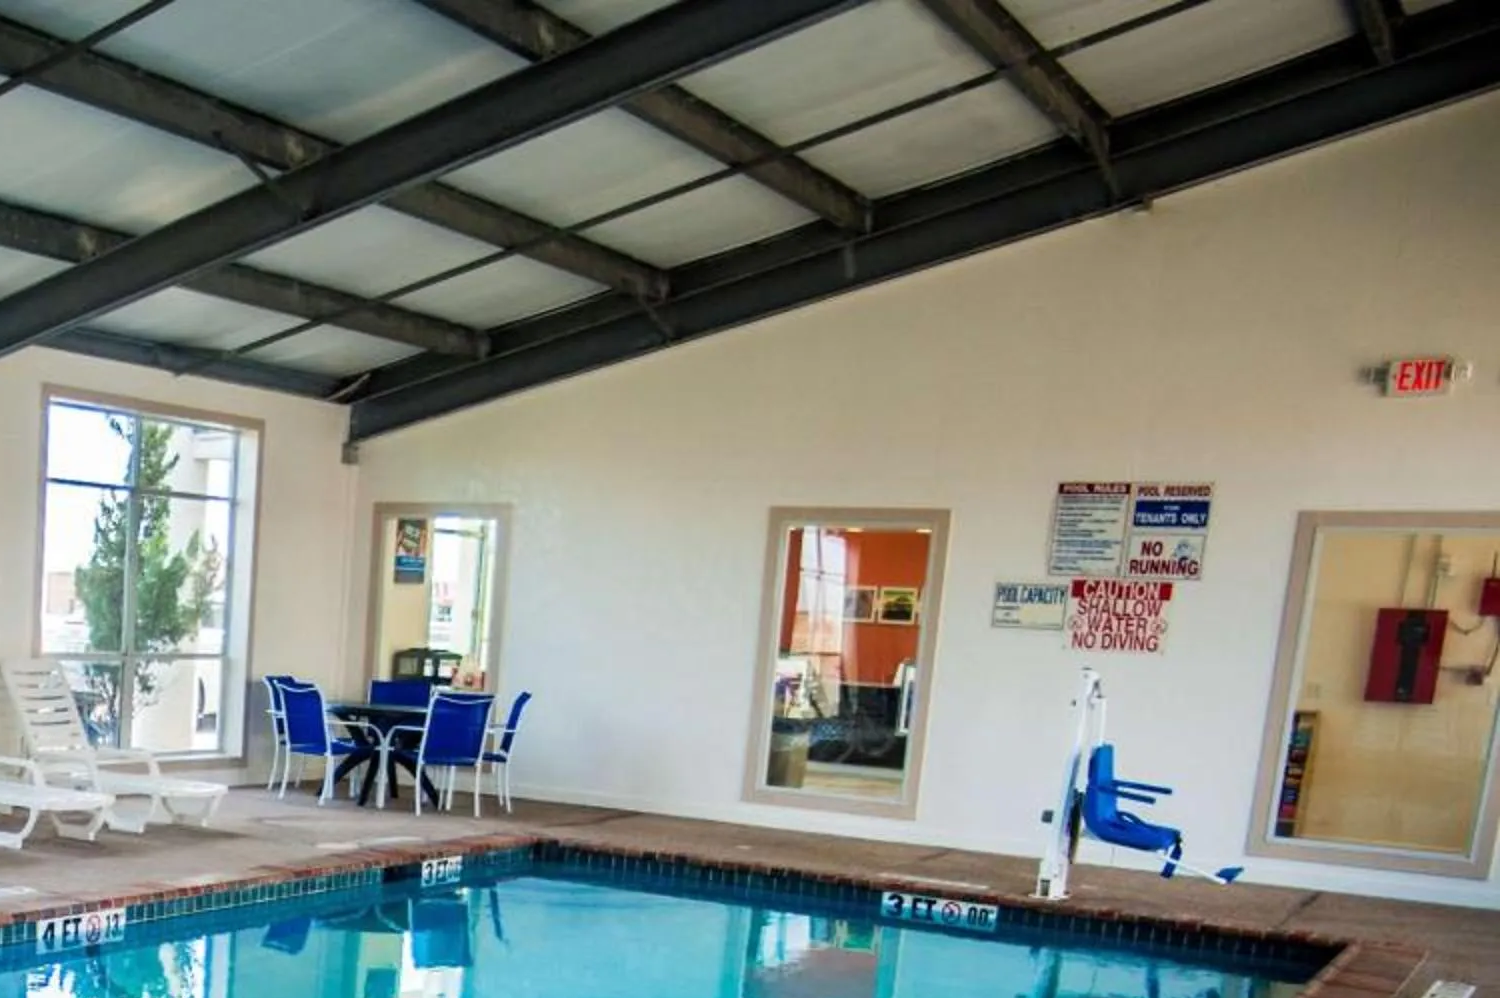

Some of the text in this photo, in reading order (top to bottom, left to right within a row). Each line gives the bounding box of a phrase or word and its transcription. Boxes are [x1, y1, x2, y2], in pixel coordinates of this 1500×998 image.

[1396, 361, 1445, 391] EXIT
[1163, 485, 1211, 497] RESERVED
[1135, 512, 1207, 526] TENANTS ONLY
[1141, 541, 1163, 556] NO
[1129, 558, 1199, 576] RUNNING
[1083, 580, 1160, 600] CAUTION
[1077, 598, 1162, 617] SHALLOW
[1087, 615, 1148, 633] WATER
[1071, 631, 1158, 652] NO DIVING
[910, 896, 937, 920] FT
[63, 917, 82, 938] FT
